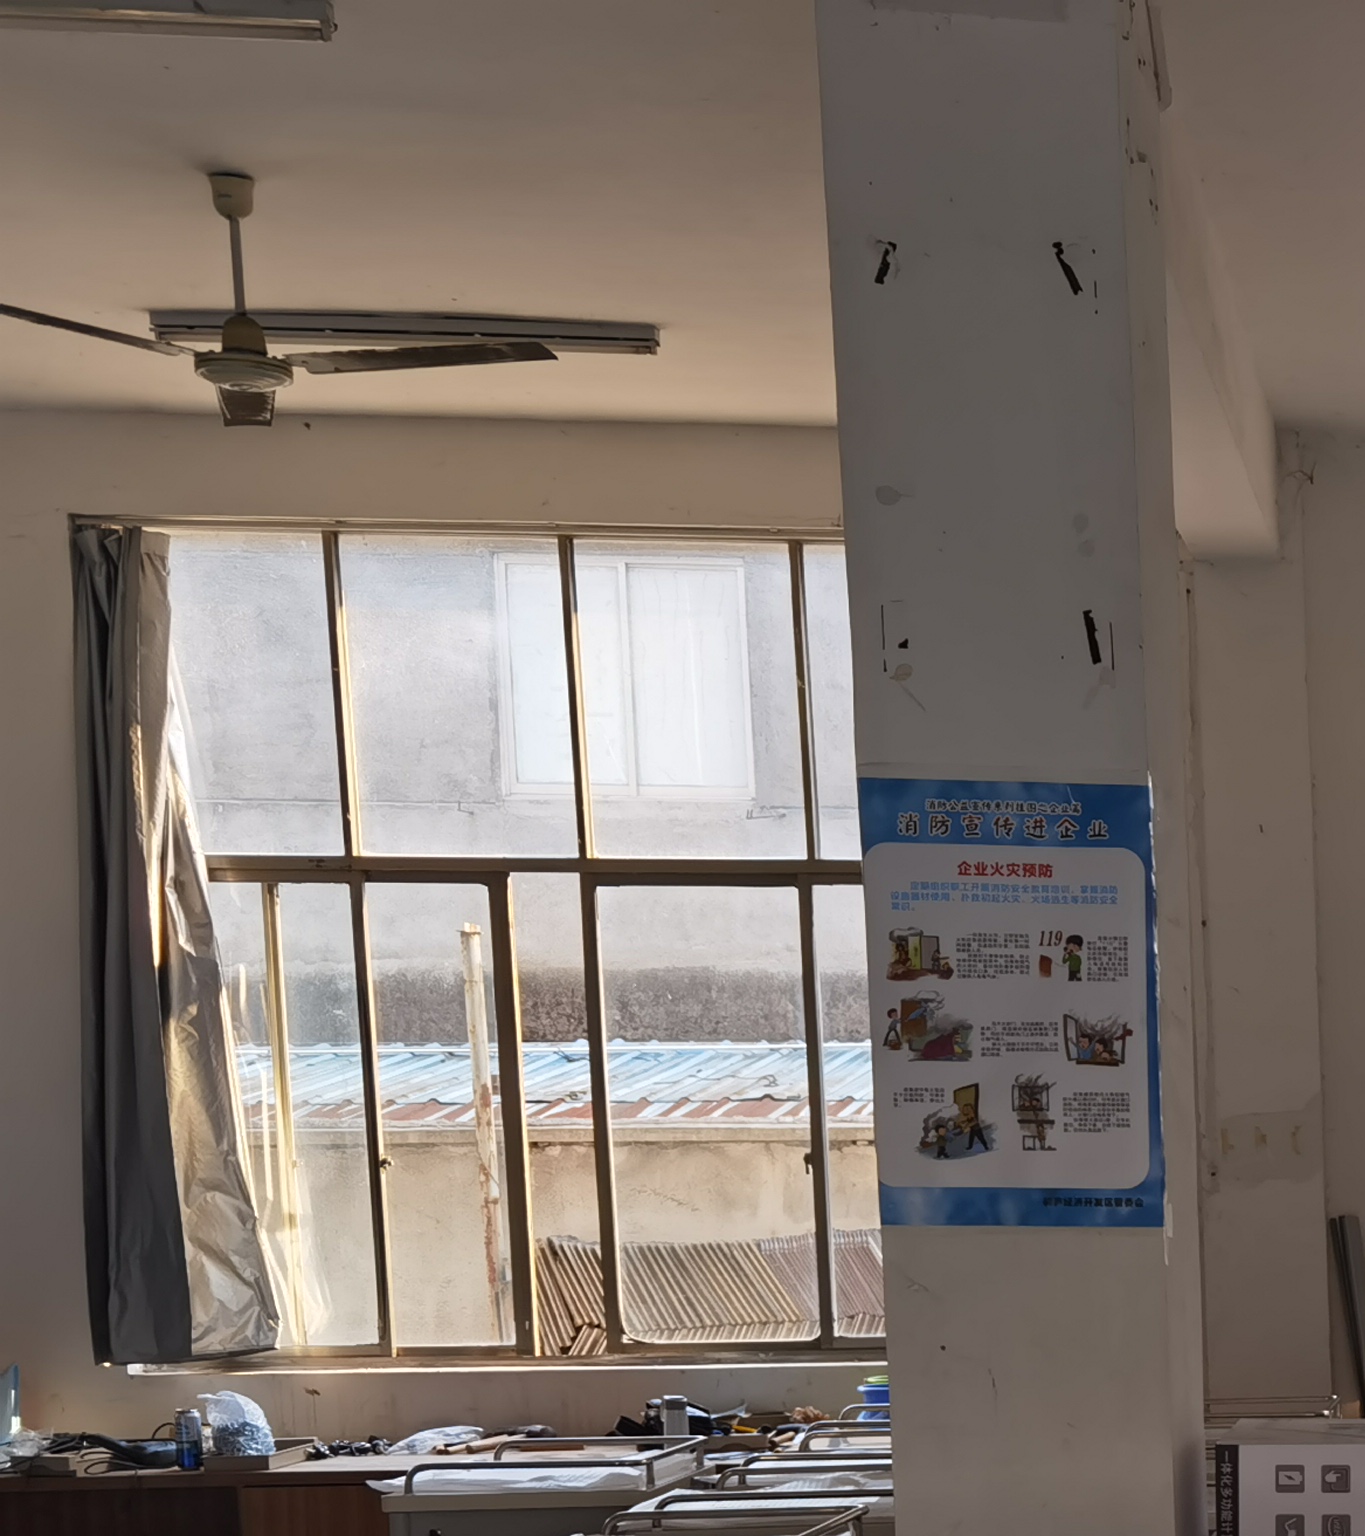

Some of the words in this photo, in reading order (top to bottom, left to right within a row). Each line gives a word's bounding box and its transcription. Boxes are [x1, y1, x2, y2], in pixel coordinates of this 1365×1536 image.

[897, 814, 1110, 841] 消防宣传进企业
[957, 861, 1053, 879] 企业火灾预防
[1038, 930, 1063, 947] 119
